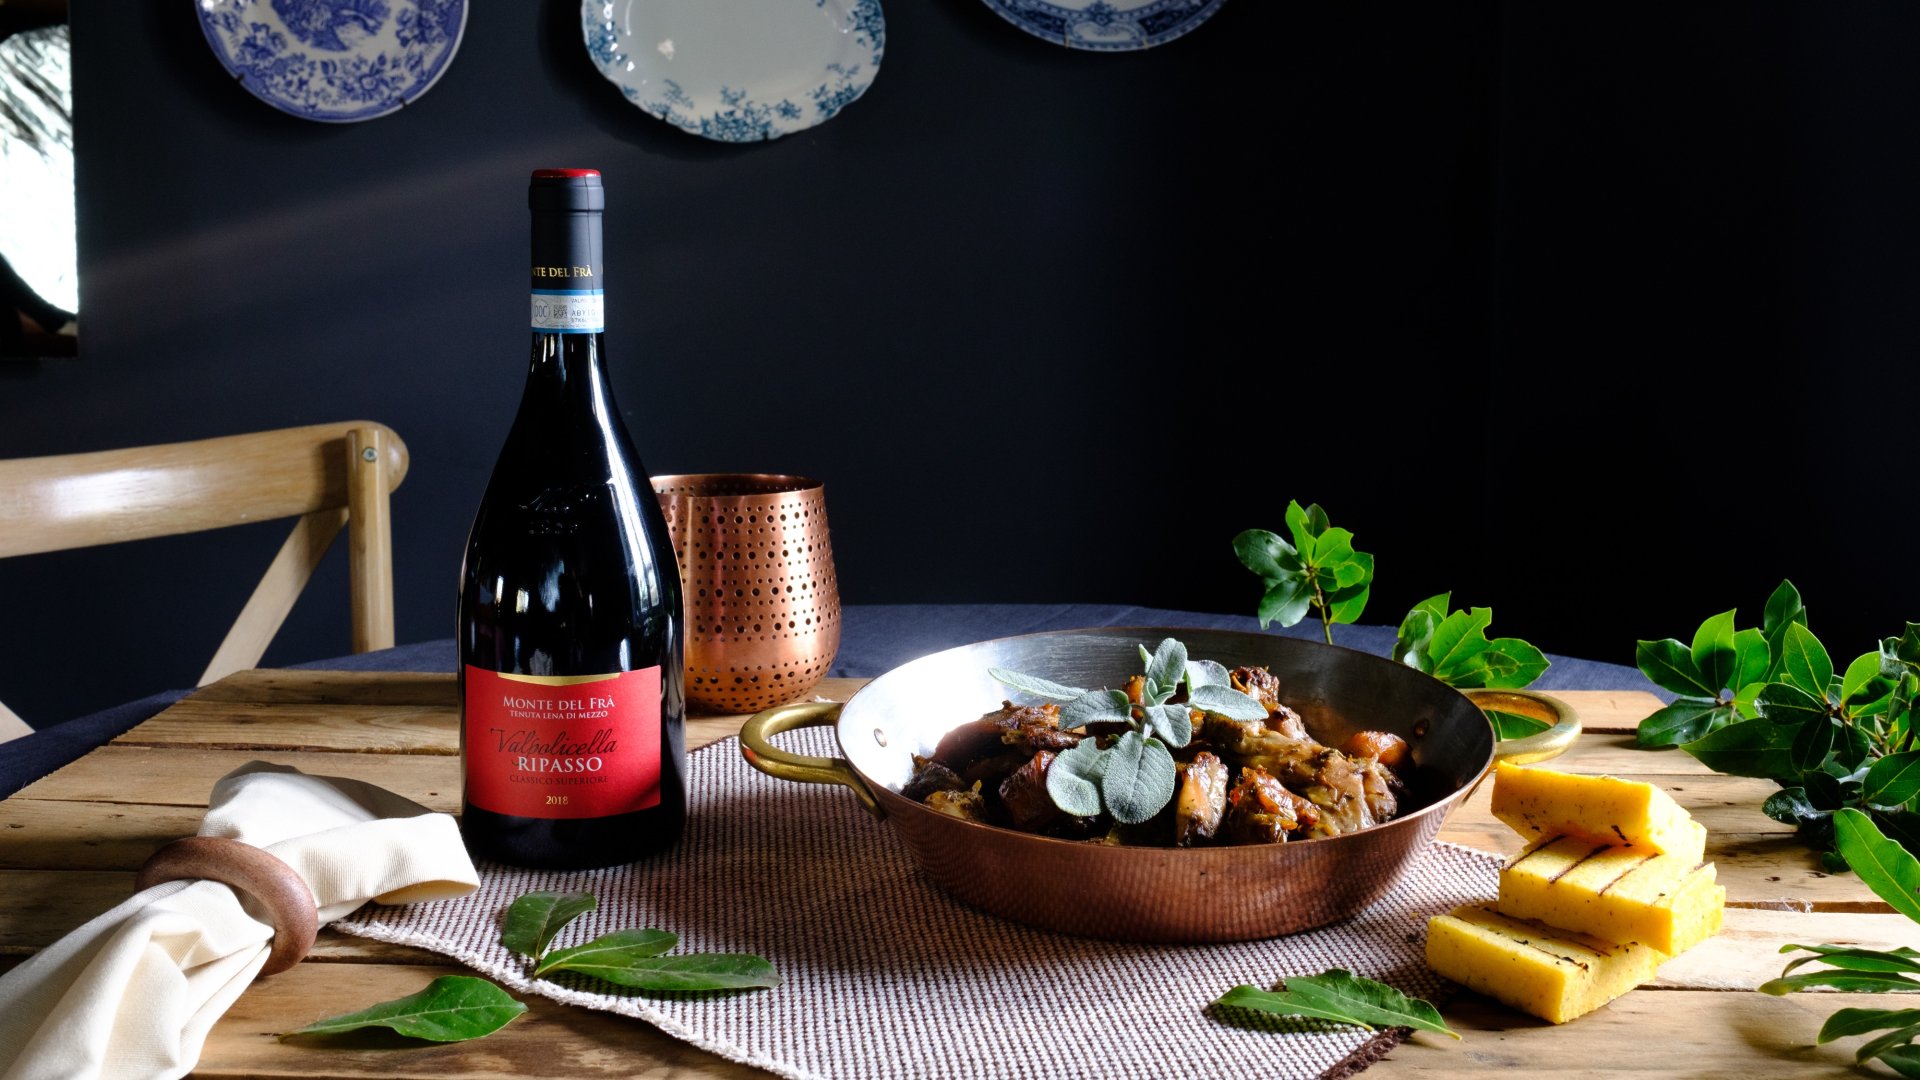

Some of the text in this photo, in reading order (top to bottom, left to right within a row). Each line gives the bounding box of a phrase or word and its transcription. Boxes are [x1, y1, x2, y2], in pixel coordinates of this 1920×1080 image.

[549, 267, 570, 277] DEL
[573, 264, 593, 277] FRÀ
[503, 694, 615, 711] MONTE DEL FRÀ
[510, 710, 541, 719] TENUTA
[543, 712, 564, 720] LENA
[578, 710, 608, 719] MEZZO
[490, 728, 619, 764] Valpolicella
[518, 756, 603, 773] RIPASSO
[510, 775, 609, 785] CLASSICO SUPERIORE
[546, 795, 569, 805] 2018
